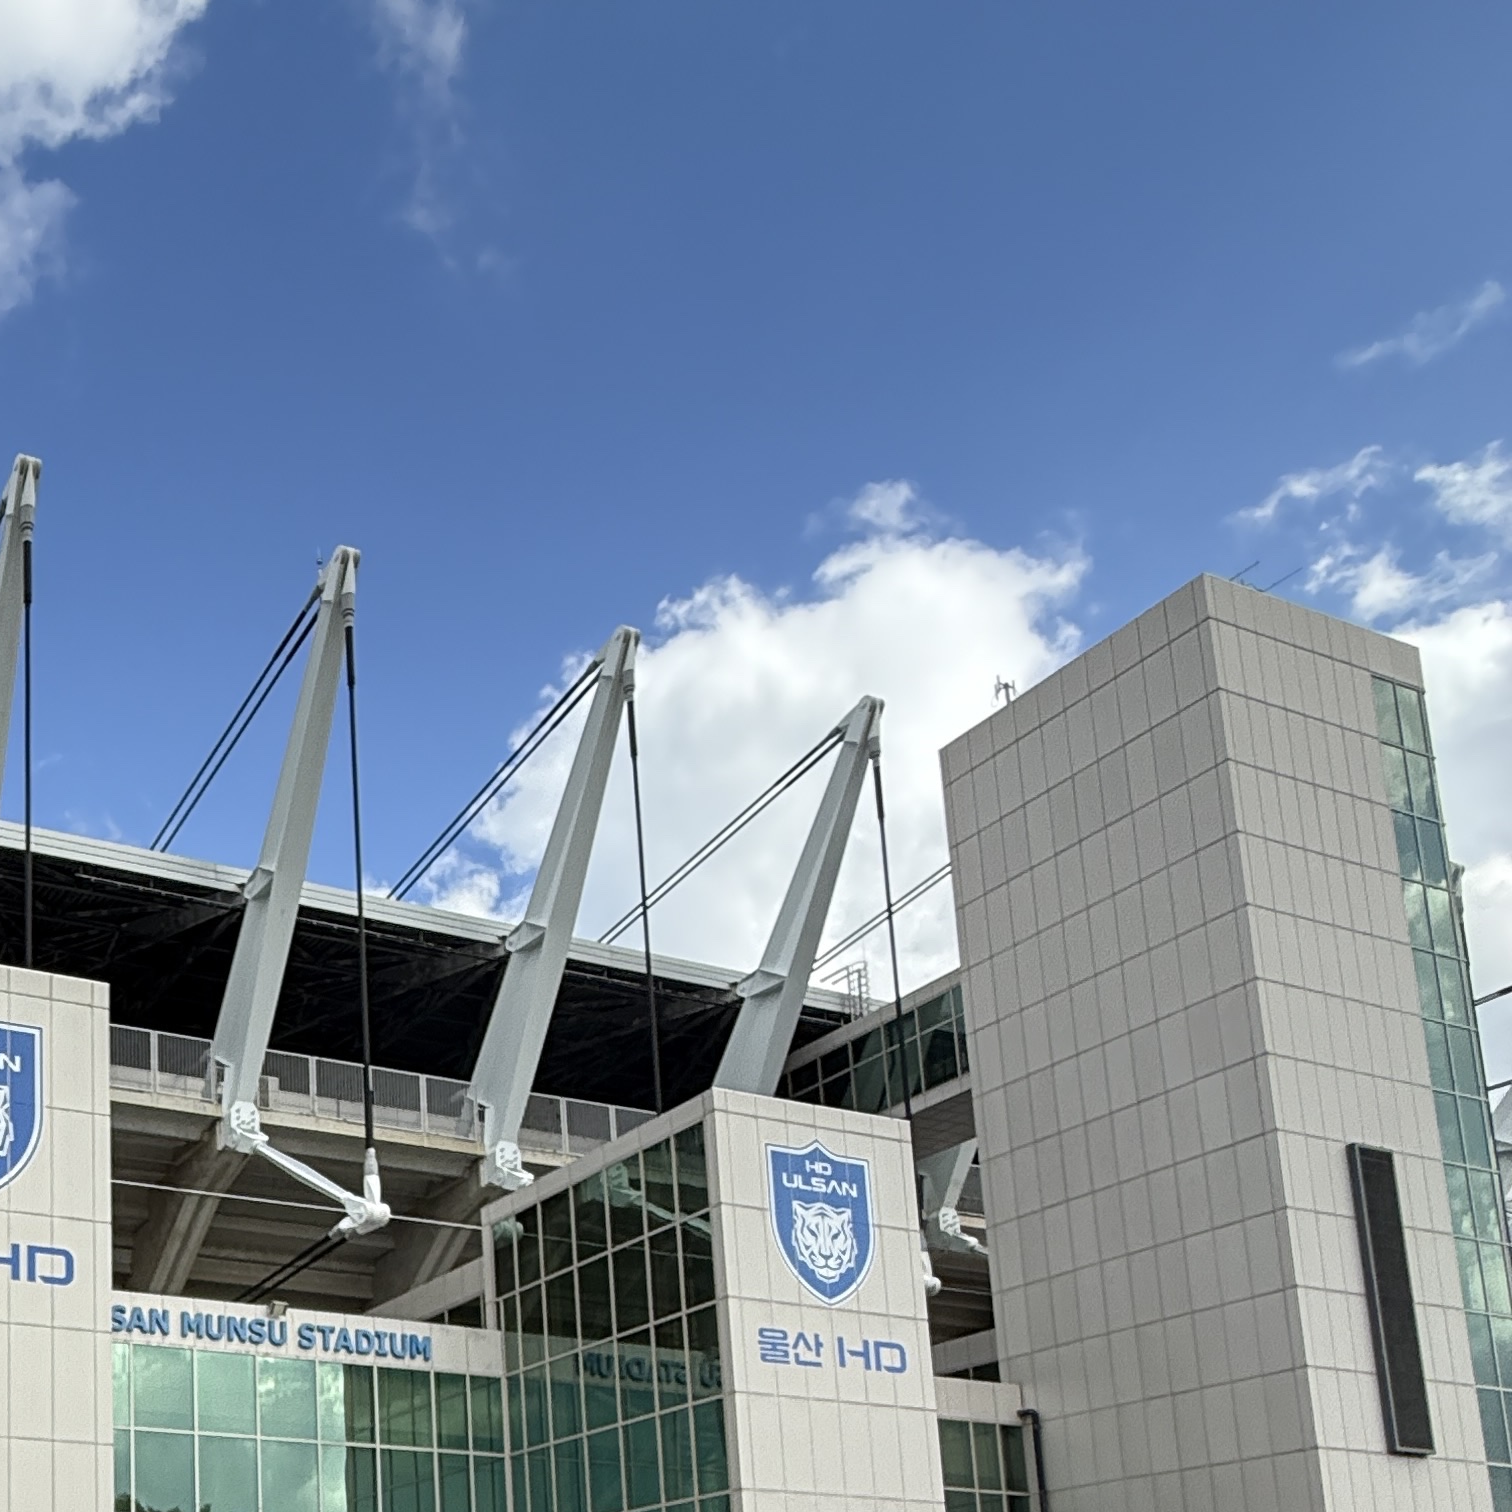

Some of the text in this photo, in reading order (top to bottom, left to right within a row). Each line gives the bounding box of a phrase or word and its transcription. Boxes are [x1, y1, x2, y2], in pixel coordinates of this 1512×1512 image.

[782, 1172, 857, 1198] ULSAN
[805, 1160, 832, 1176] HD
[180, 1311, 287, 1347] MUNSU
[297, 1322, 432, 1362] STADIUM
[758, 1327, 907, 1374] 울산 HD
